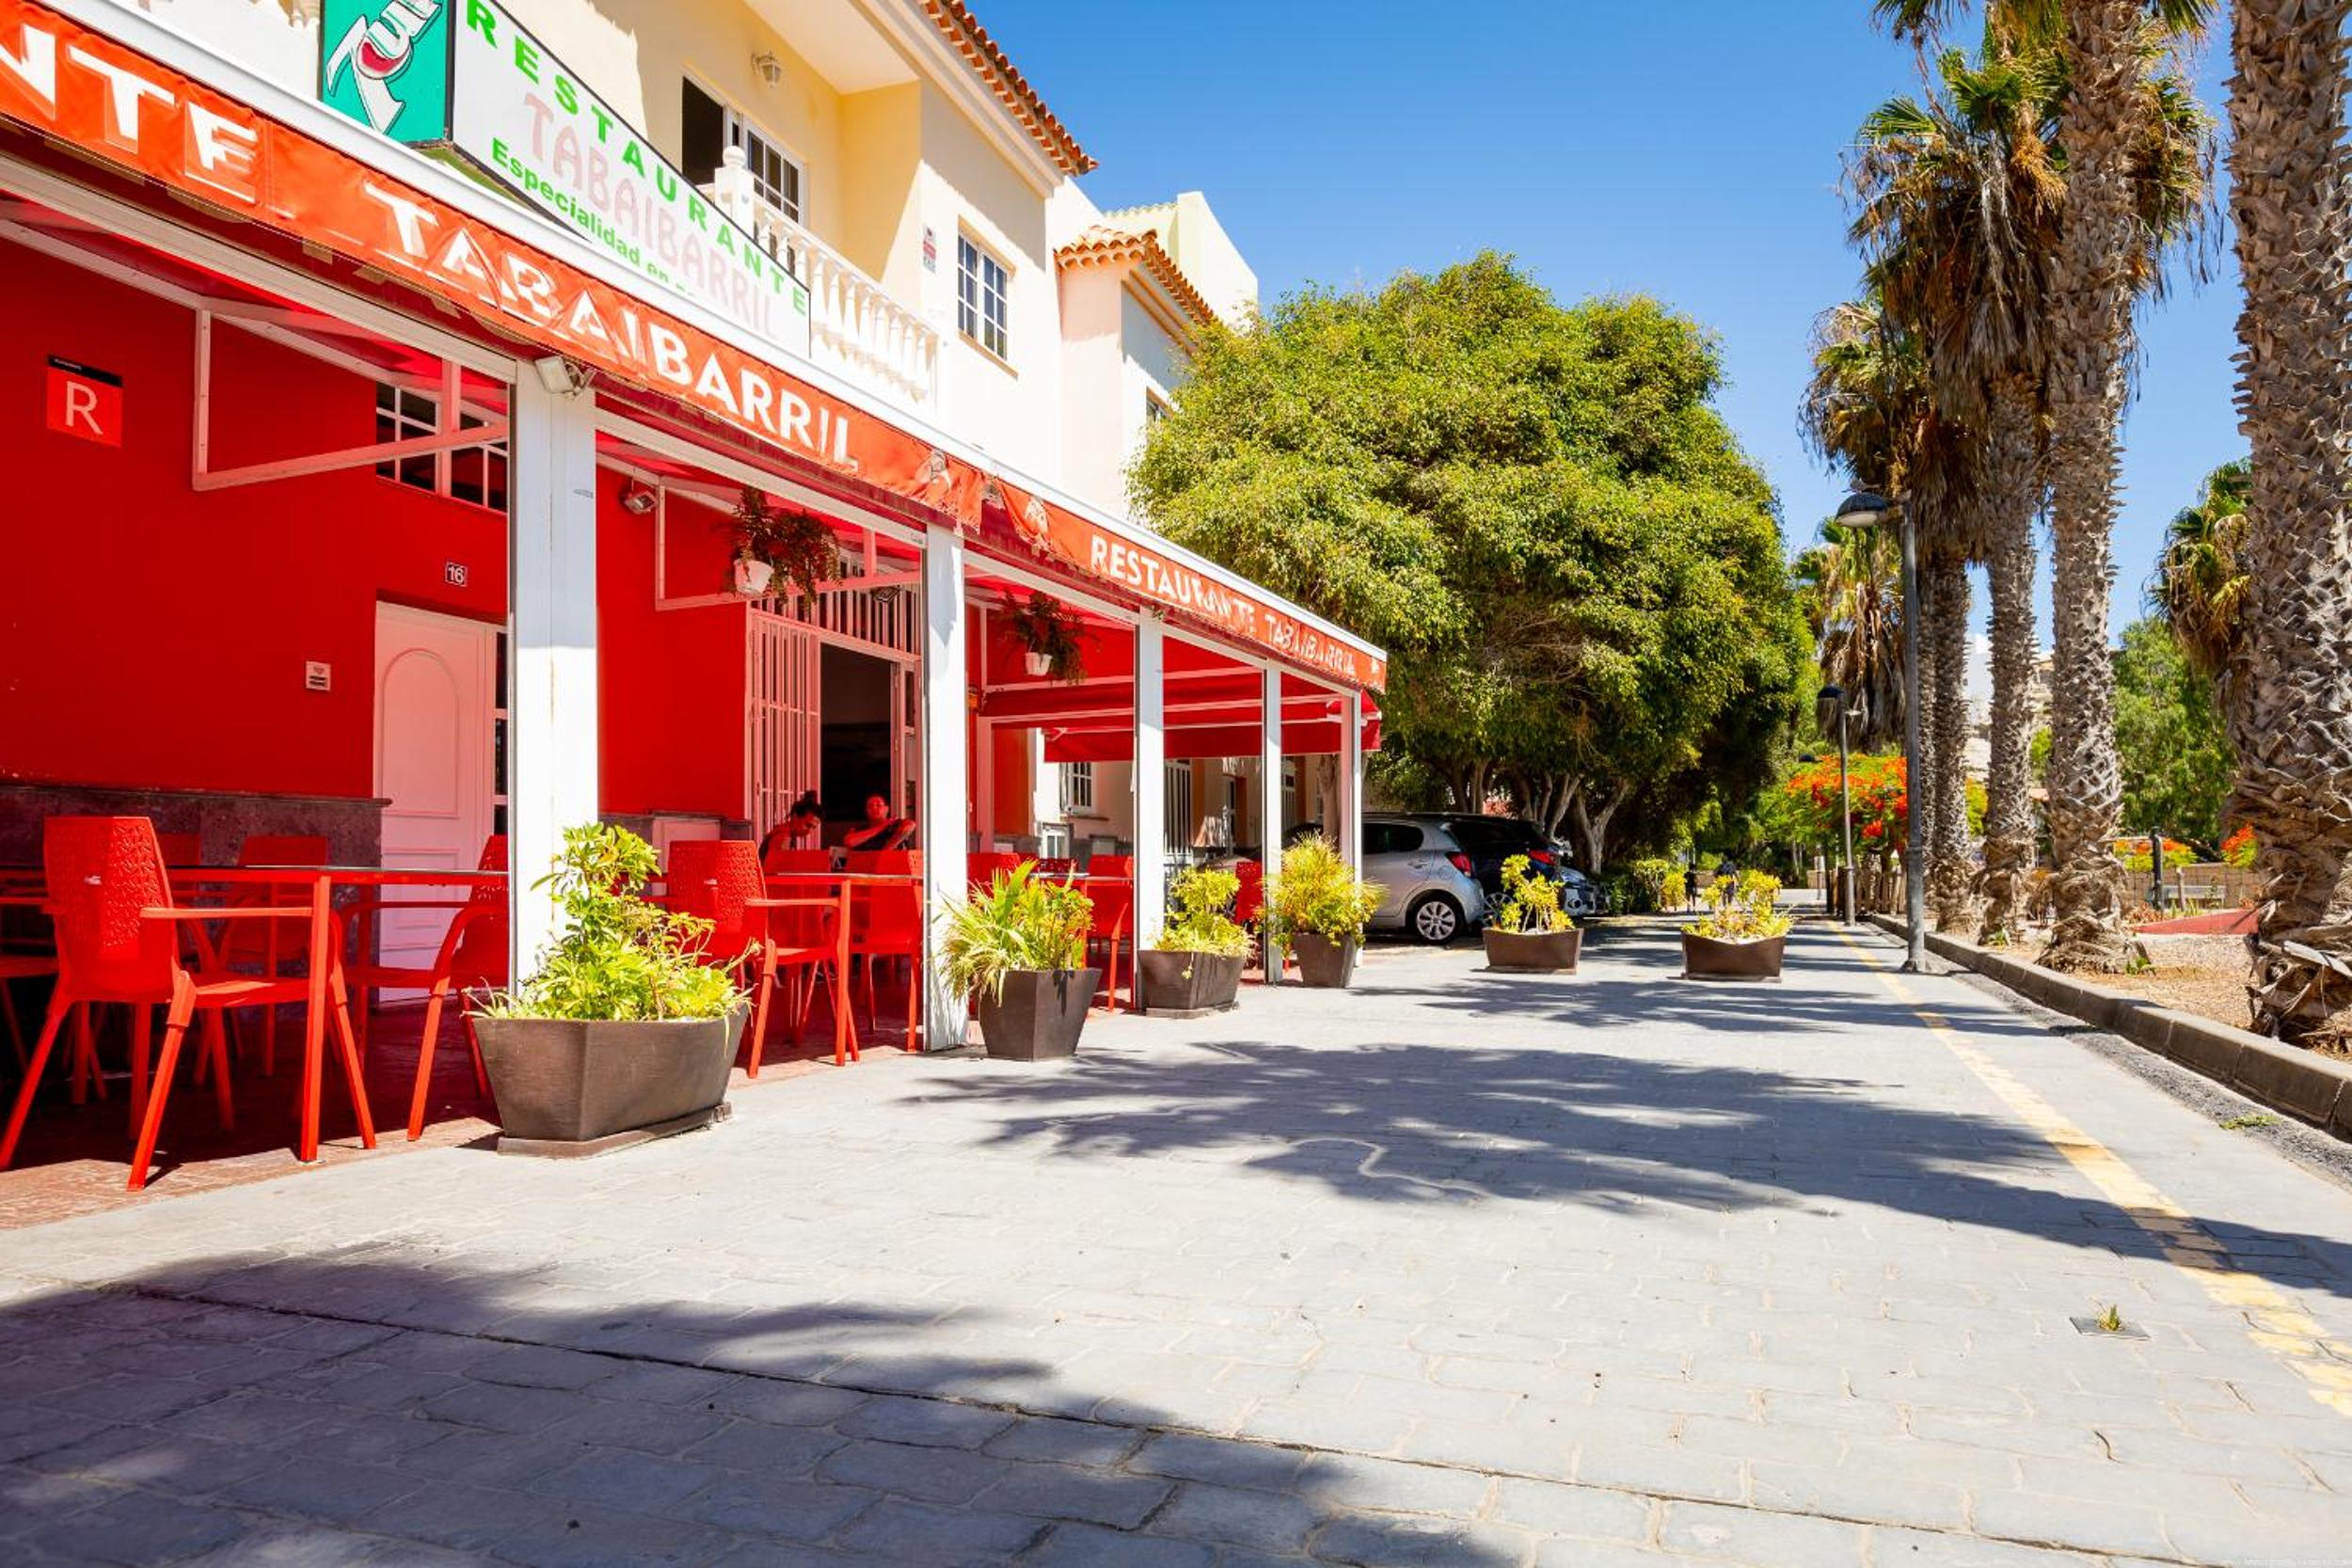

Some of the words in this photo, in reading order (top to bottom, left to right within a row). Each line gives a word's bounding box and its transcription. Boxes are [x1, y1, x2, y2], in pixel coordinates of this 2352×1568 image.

[467, 0, 807, 317] RESTAURANTE
[491, 136, 641, 267] Especialidad
[524, 91, 775, 338] TABAIBARRIL
[66, 380, 103, 435] R
[361, 180, 860, 472] TABAIBARRIL
[448, 565, 465, 584] 16
